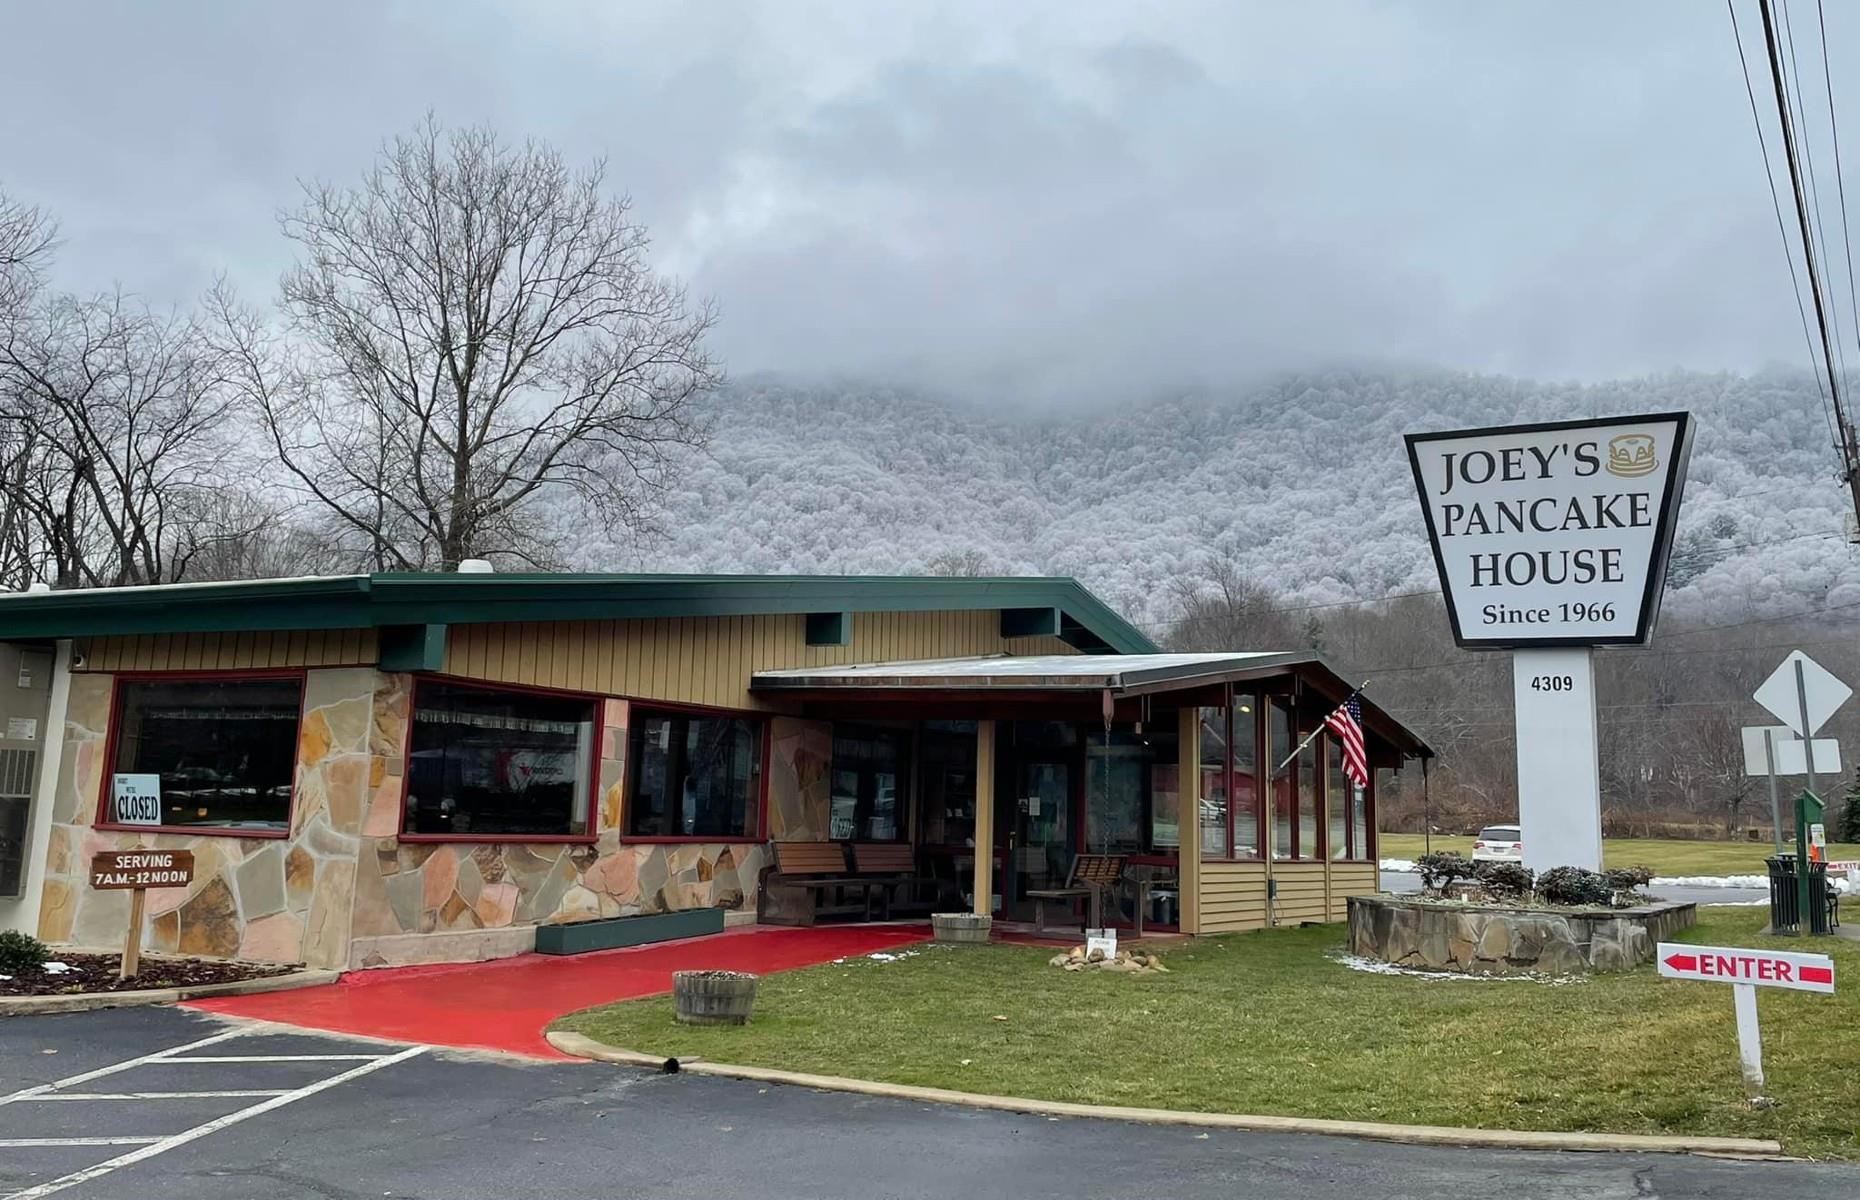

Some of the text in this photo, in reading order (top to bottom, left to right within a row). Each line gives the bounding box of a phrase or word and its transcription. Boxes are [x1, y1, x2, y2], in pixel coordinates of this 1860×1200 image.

[1440, 442, 1600, 496] JOEY'S
[1440, 492, 1652, 538] PANCAKE
[1469, 548, 1624, 588] HOUSE
[1482, 601, 1616, 624] Since 1966
[1531, 675, 1573, 692] 4309
[117, 795, 158, 820] CLOSED
[115, 854, 173, 869] SERVING
[1699, 953, 1794, 983] ENTER
